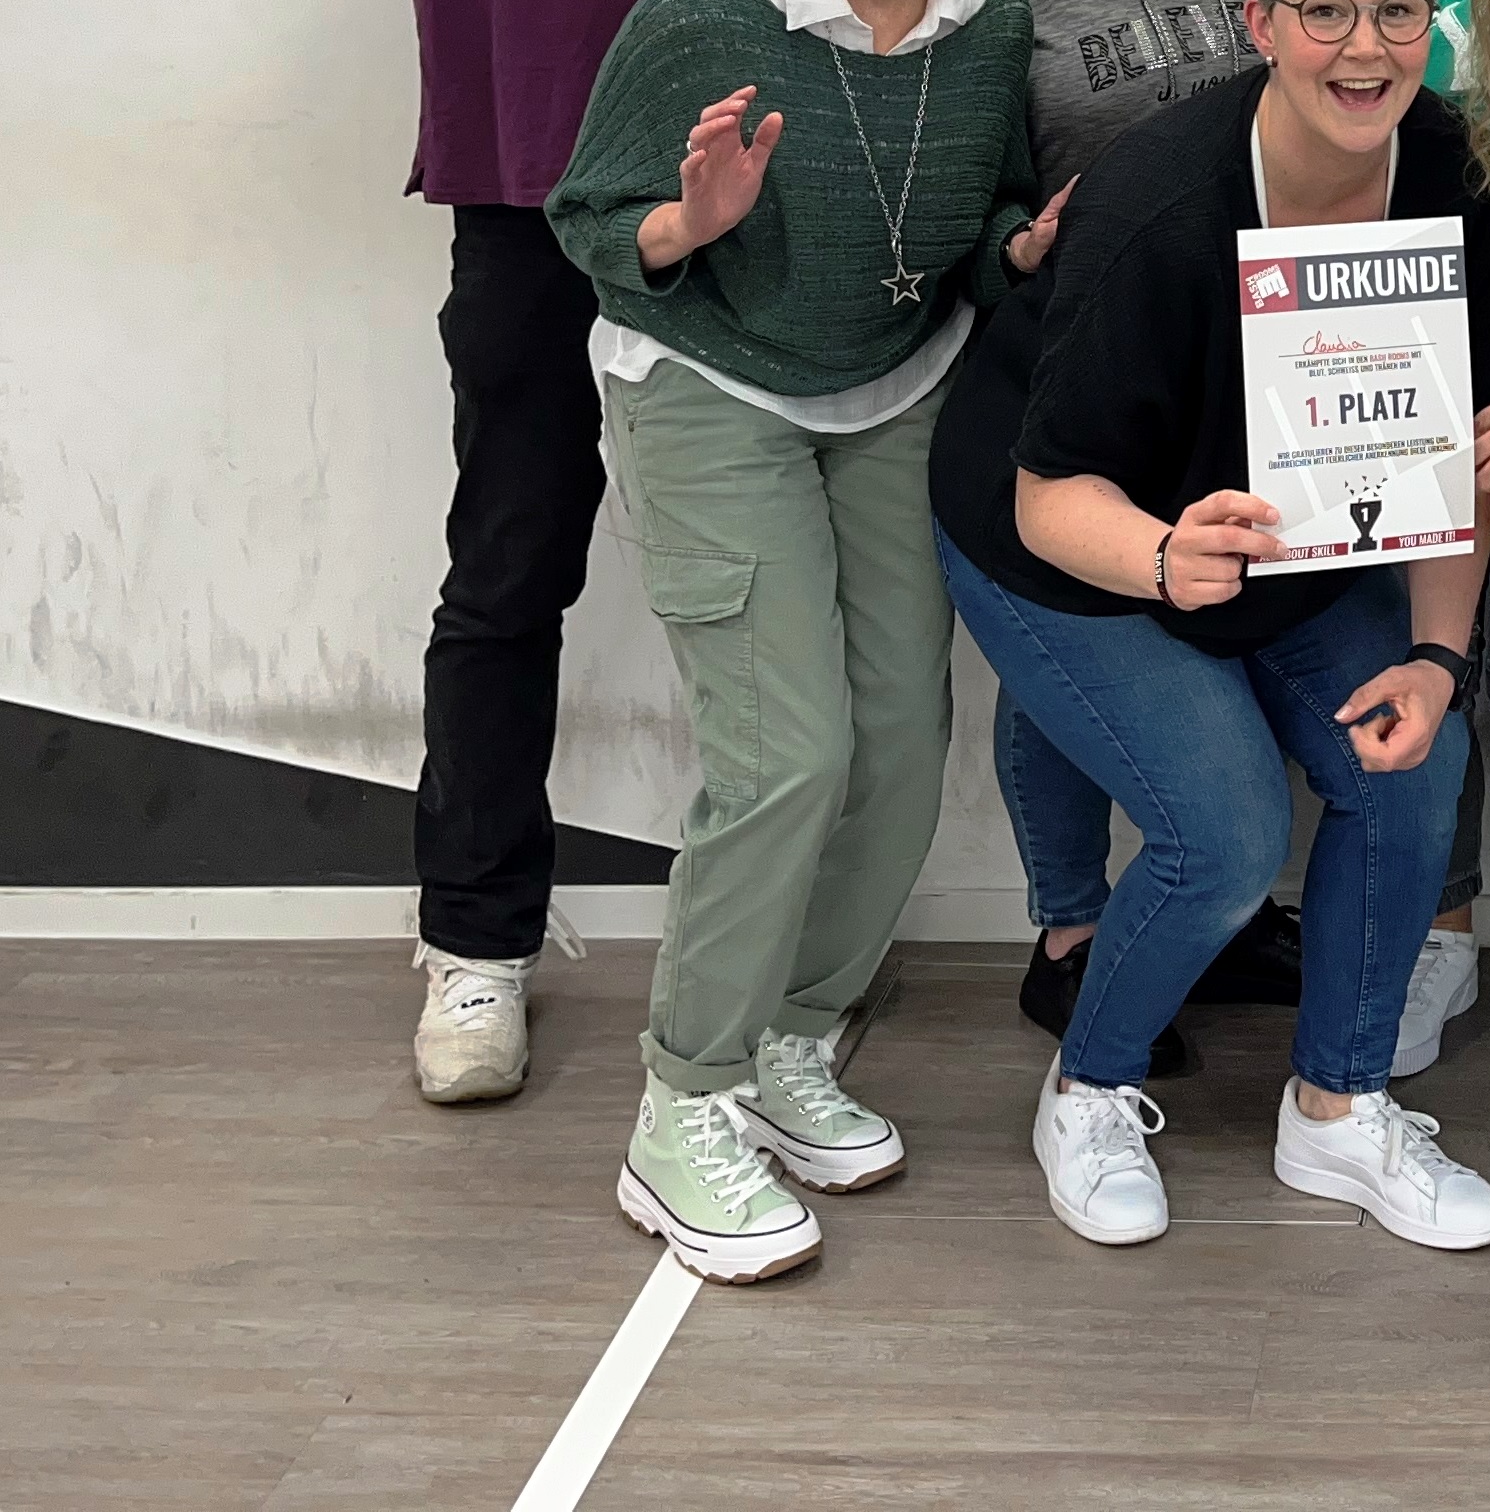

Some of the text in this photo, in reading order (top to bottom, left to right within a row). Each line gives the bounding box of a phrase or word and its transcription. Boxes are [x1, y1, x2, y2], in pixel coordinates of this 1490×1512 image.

[1305, 254, 1459, 302] URKUNDE
[1303, 330, 1366, 355] Claudia
[1306, 388, 1418, 427] 1. PLATZ
[1361, 507, 1368, 522] 1
[1399, 531, 1456, 547] YOU MADE IT!
[1285, 549, 1309, 560] BOUT
[1311, 545, 1336, 558] SKILL
[1155, 552, 1163, 583] BASH
